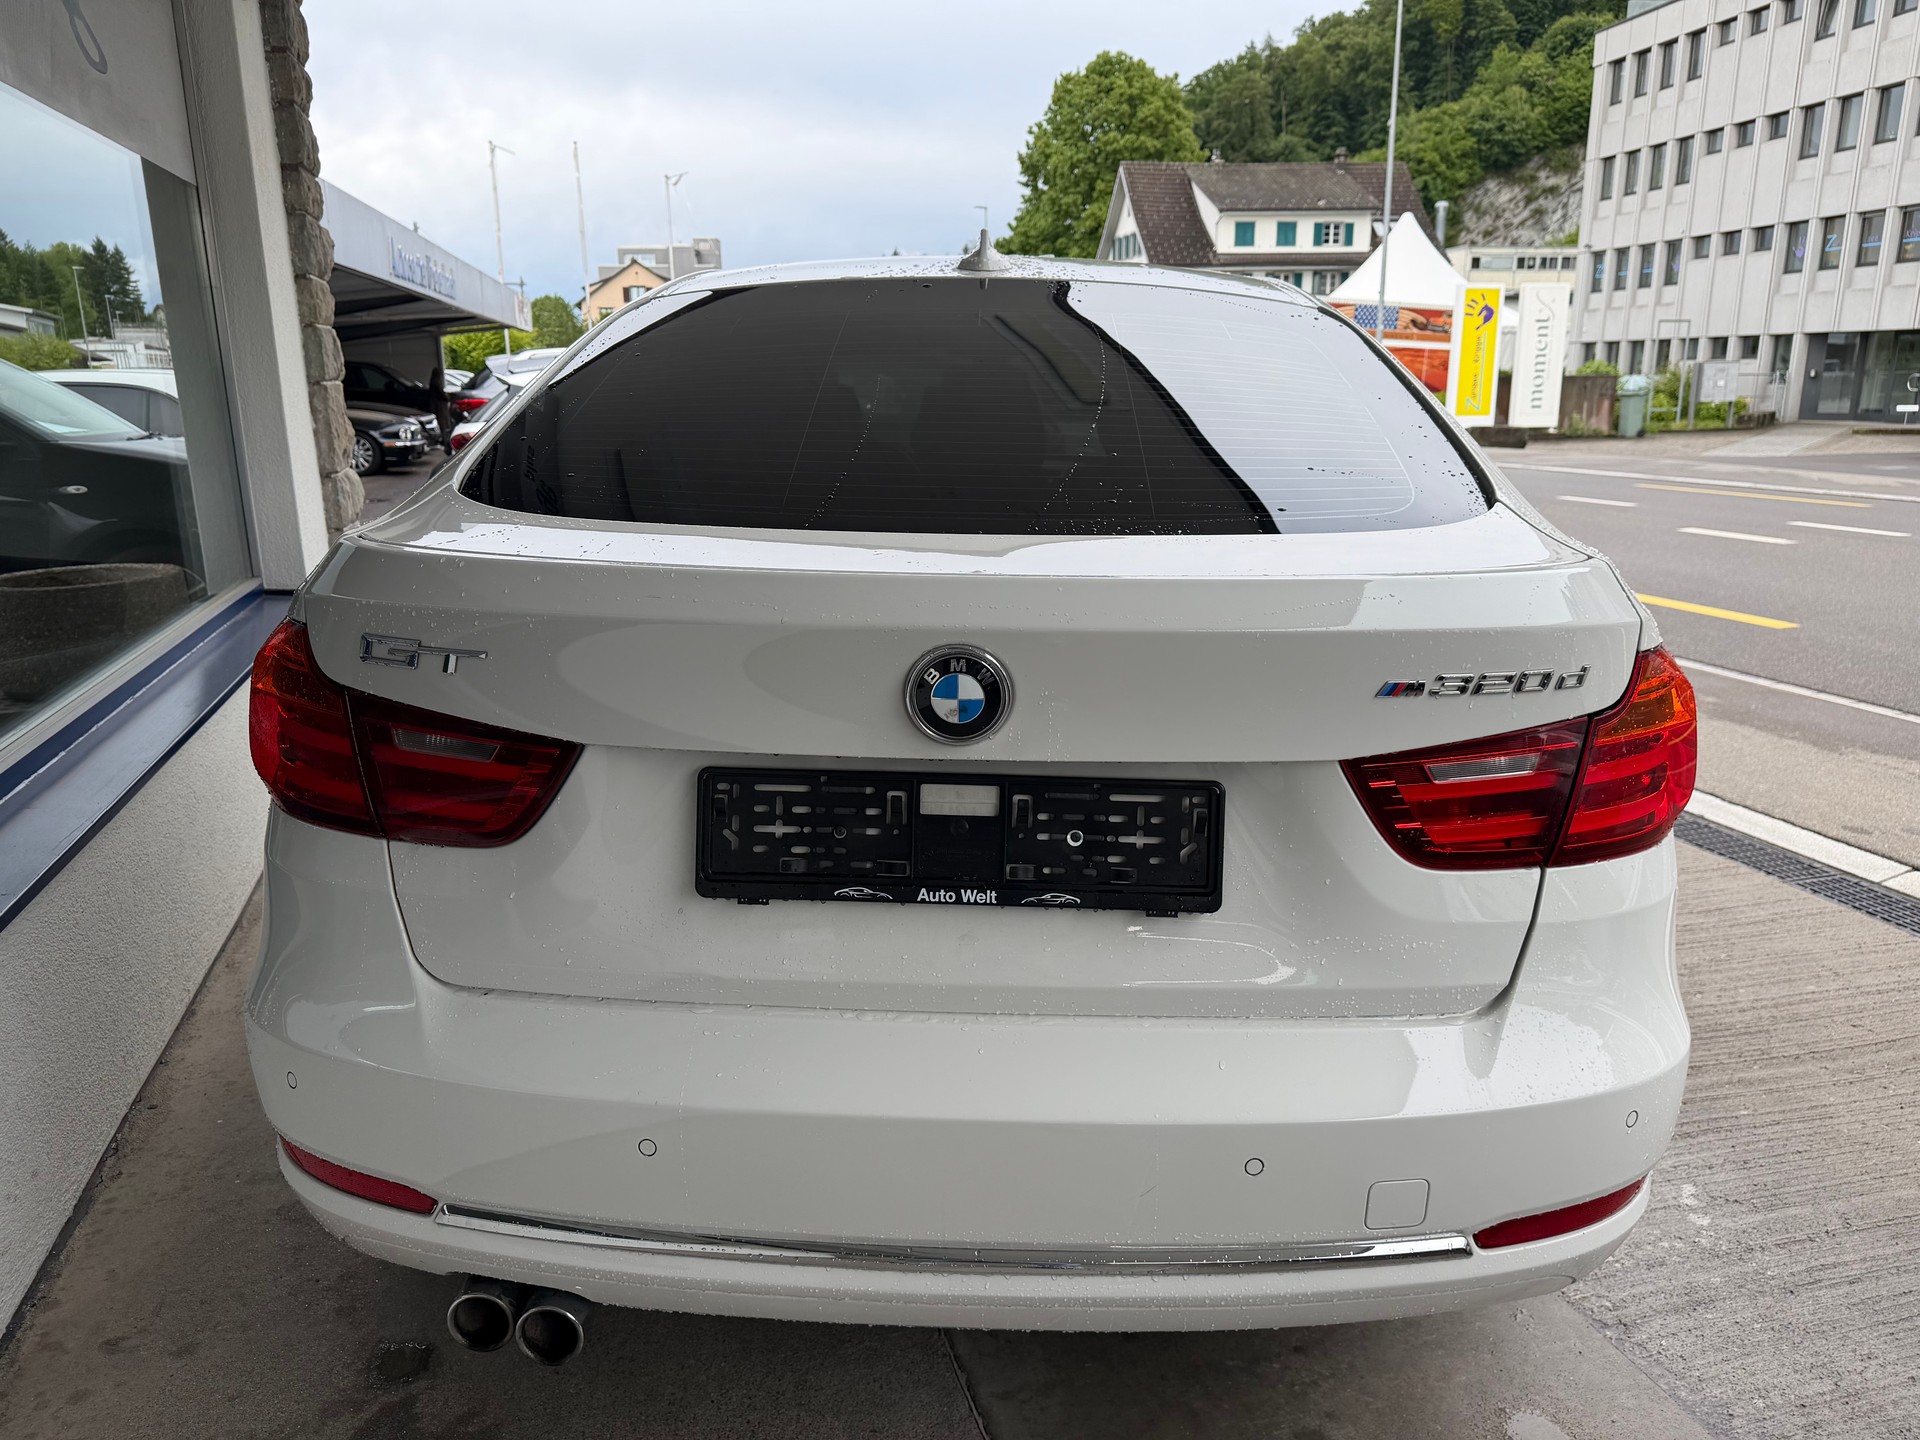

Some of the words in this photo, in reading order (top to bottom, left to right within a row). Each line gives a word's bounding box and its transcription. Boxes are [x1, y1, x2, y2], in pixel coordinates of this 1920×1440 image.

[360, 633, 488, 675] GT
[923, 658, 995, 685] BMW
[1428, 664, 1591, 697] 320d
[917, 888, 956, 902] Auto
[960, 889, 998, 904] Welt
